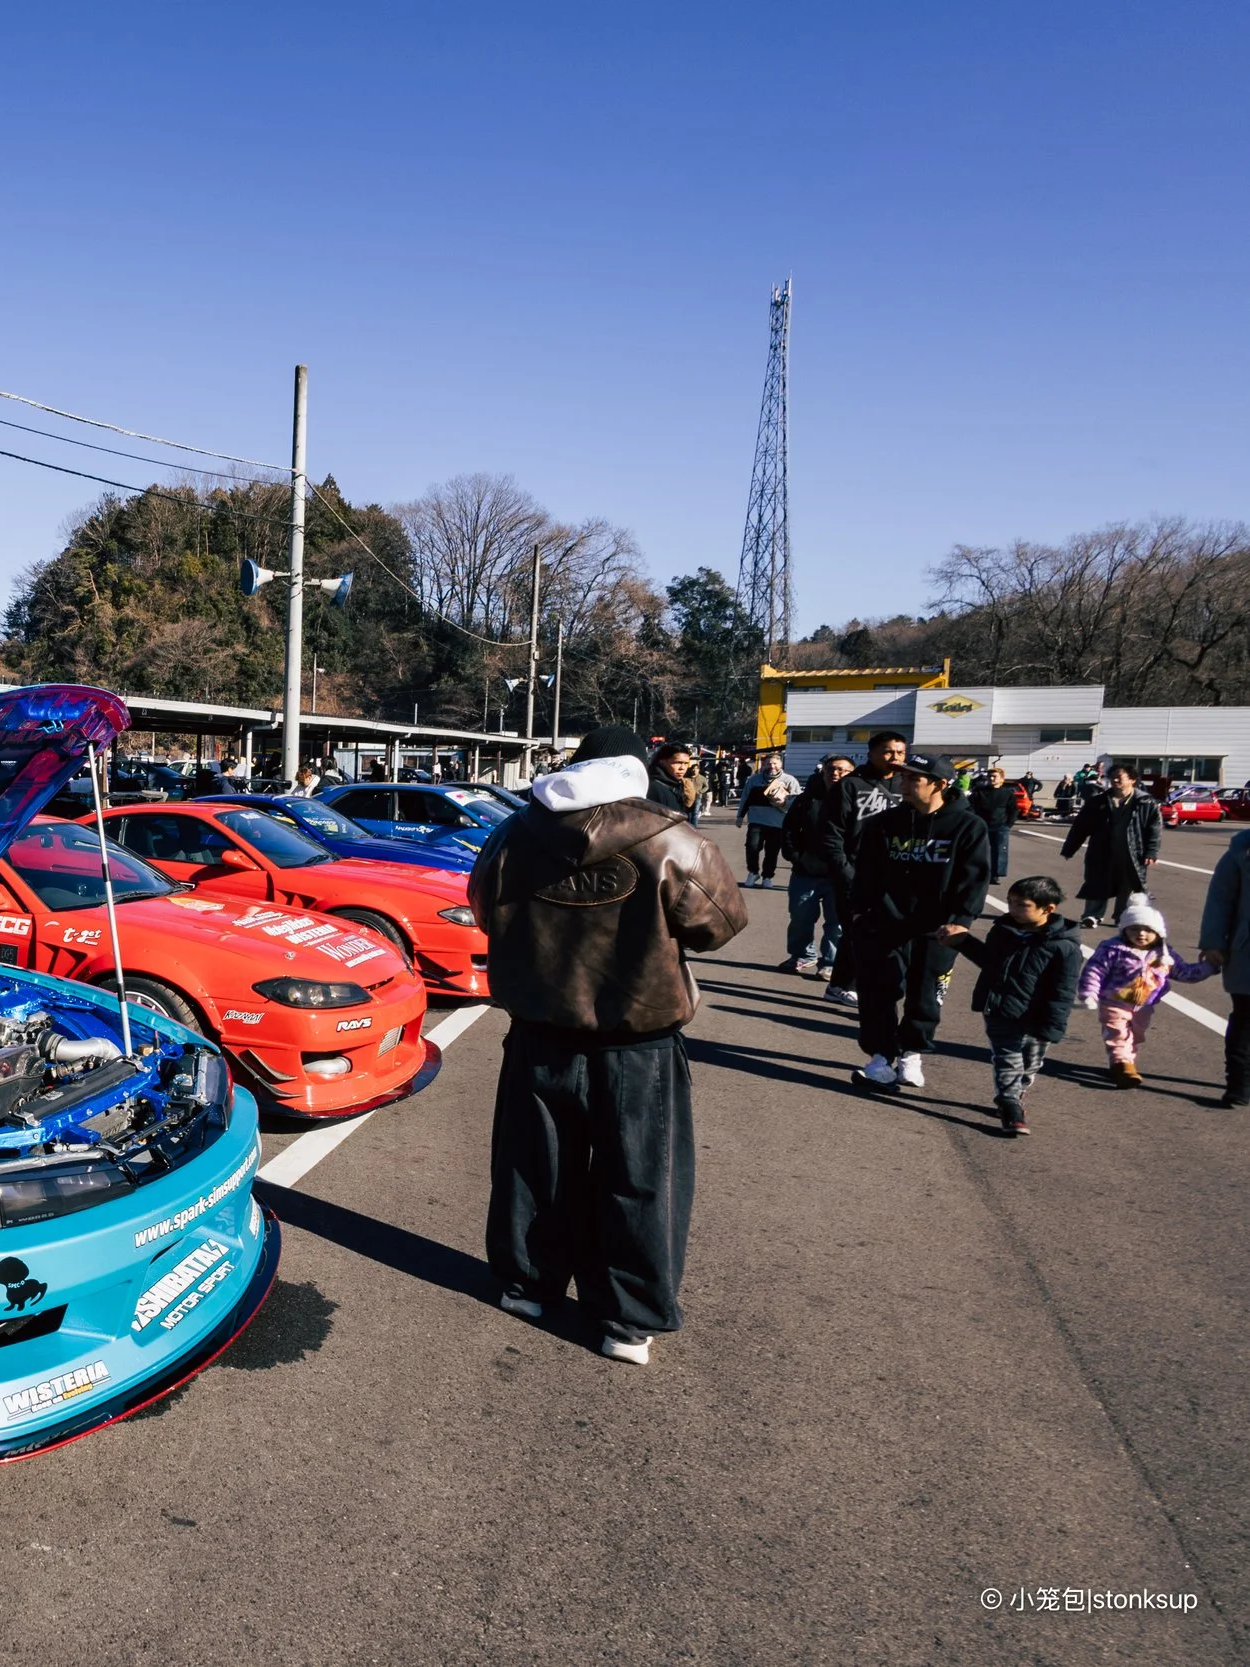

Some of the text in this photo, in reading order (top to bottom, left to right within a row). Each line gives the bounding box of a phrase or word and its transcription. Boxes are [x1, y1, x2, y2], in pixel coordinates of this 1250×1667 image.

[336, 1017, 372, 1032] RAYS
[159, 1260, 237, 1331] MOTOR SPORT
[3, 1359, 111, 1415] WISTERIA
